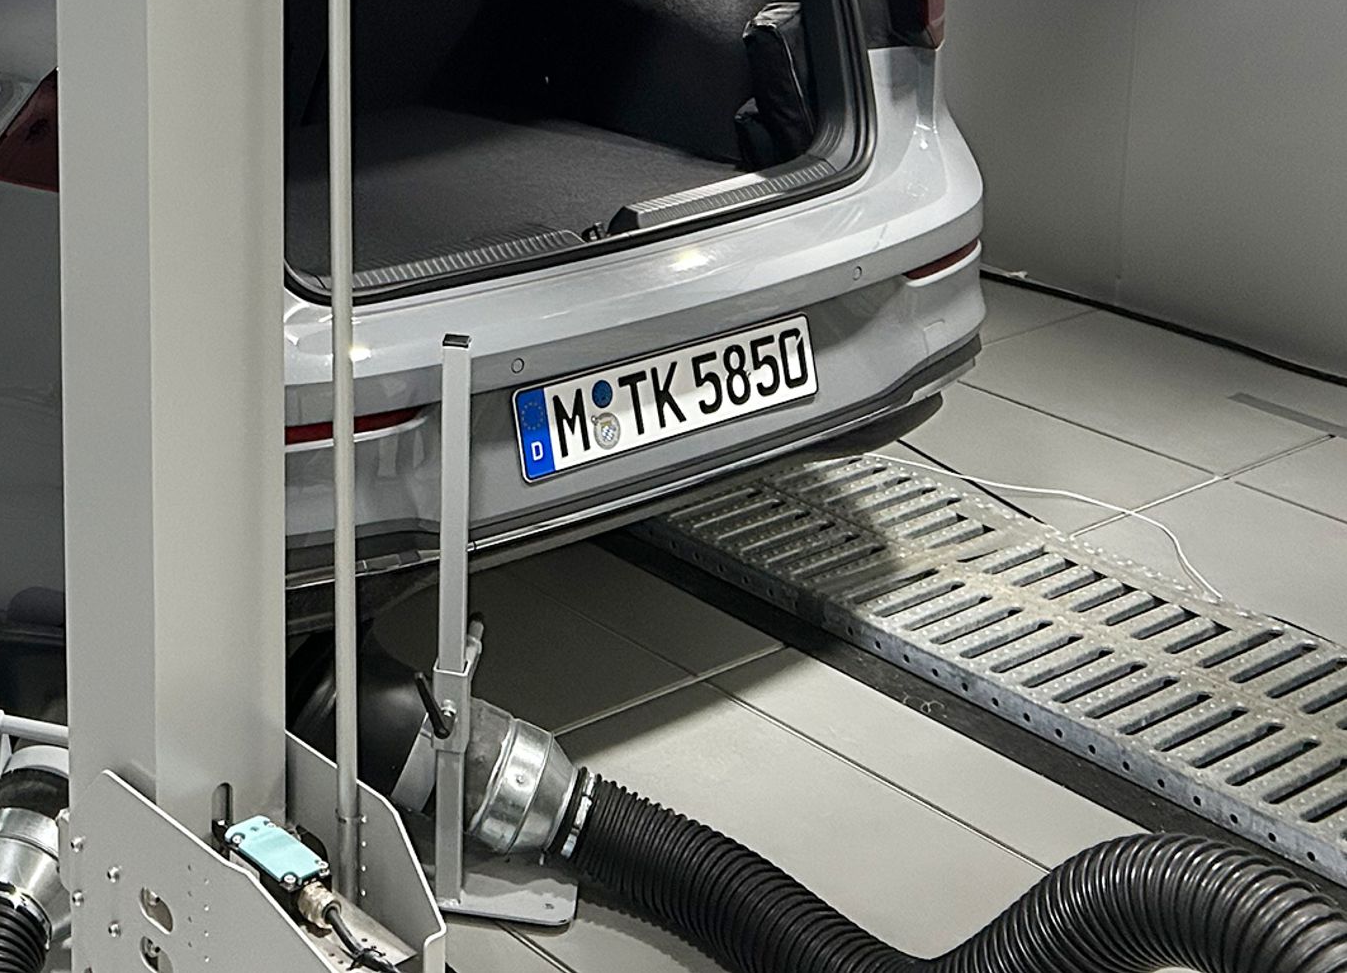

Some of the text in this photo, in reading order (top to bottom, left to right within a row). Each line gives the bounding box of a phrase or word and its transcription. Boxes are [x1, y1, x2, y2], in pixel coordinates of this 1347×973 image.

[552, 328, 809, 458] M TK 5850
[530, 440, 544, 462] D
